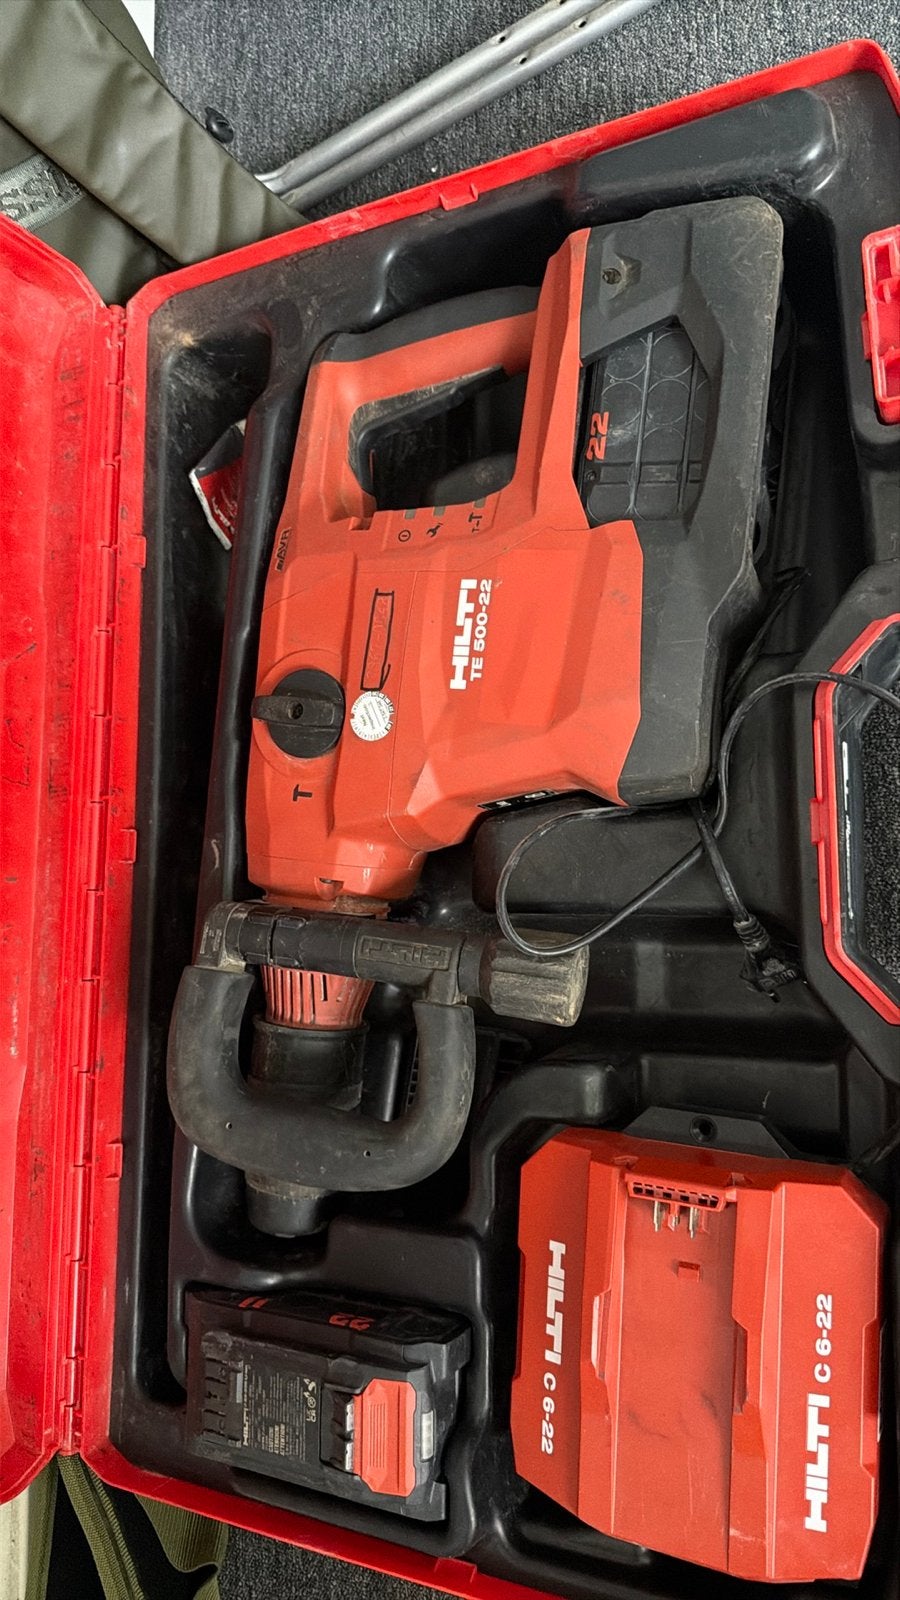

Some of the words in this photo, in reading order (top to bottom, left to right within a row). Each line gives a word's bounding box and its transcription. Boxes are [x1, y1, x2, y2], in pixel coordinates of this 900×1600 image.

[585, 411, 609, 461] 22
[449, 578, 478, 690] HILTI
[473, 579, 493, 652] 500-22
[470, 657, 484, 682] TE
[544, 1239, 566, 1366] HILTI
[815, 1293, 833, 1357] 6-22
[543, 1371, 557, 1392] C
[813, 1362, 832, 1384] C
[541, 1396, 555, 1455] 6-22
[804, 1392, 831, 1534] HILTI
